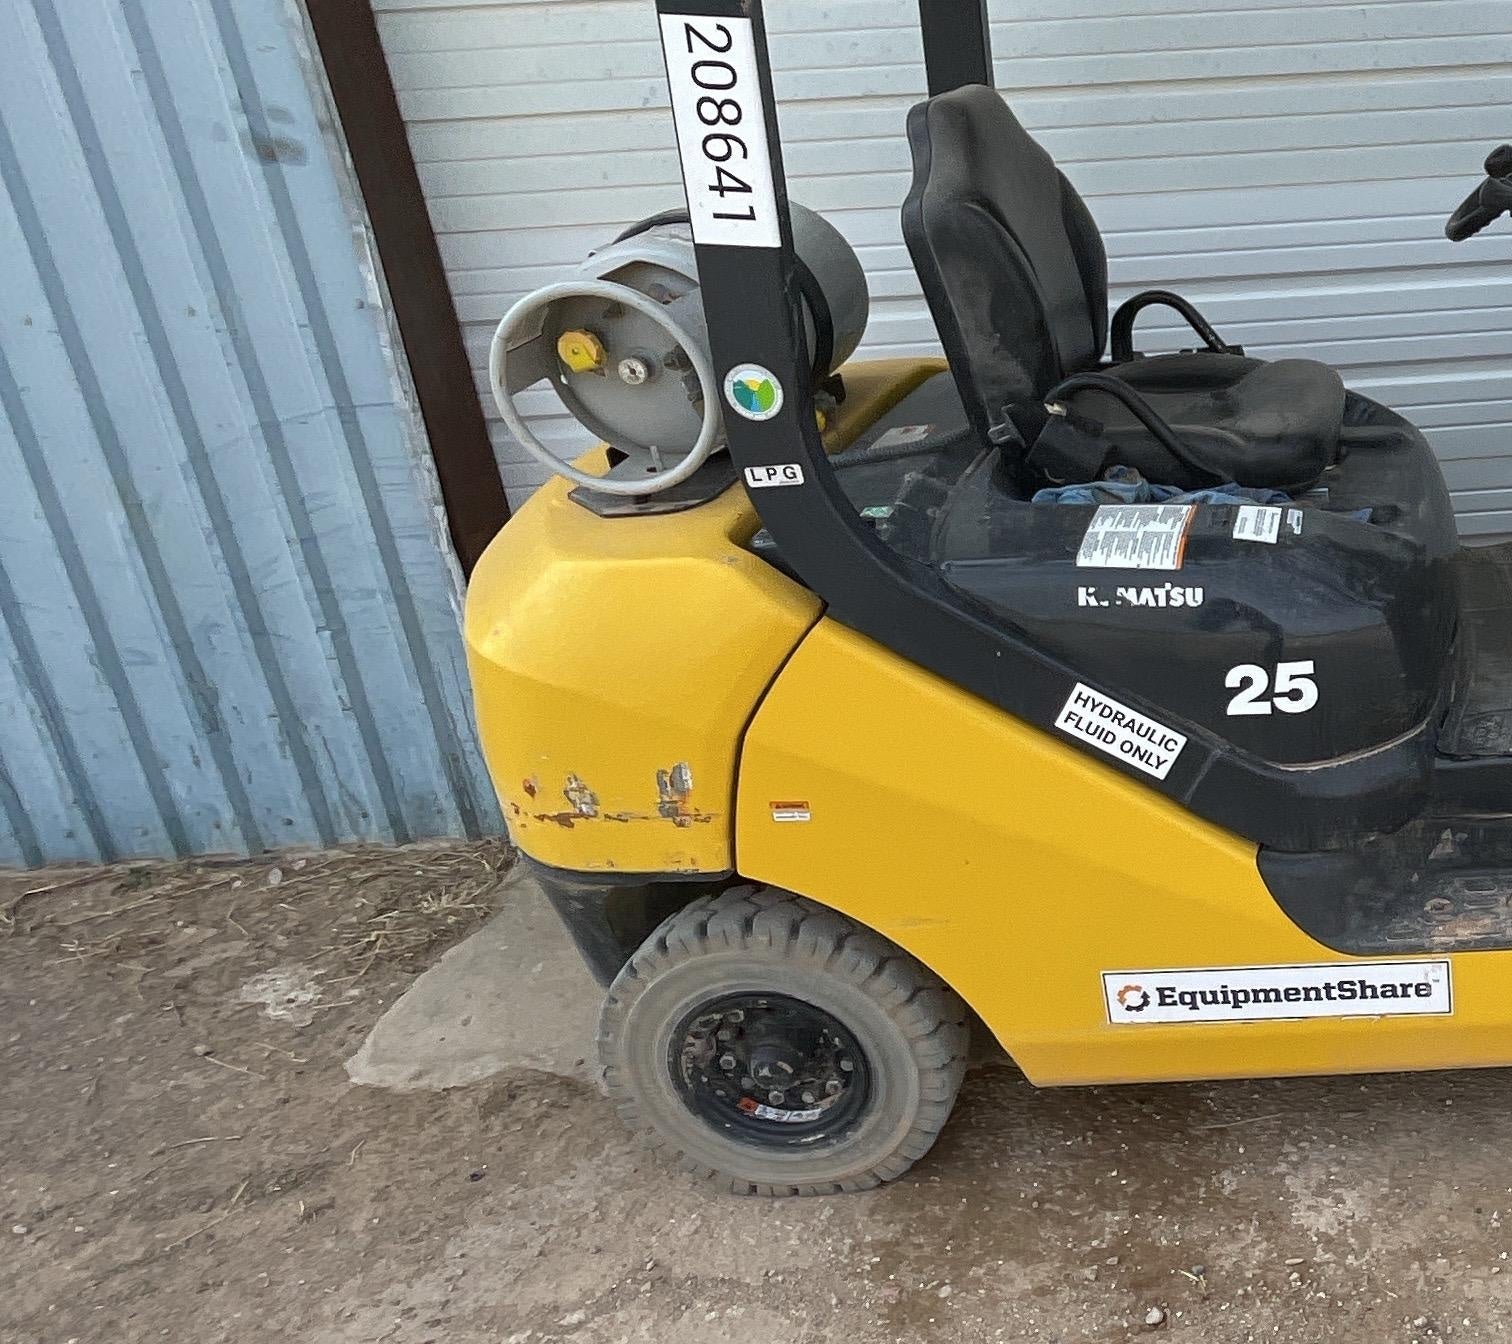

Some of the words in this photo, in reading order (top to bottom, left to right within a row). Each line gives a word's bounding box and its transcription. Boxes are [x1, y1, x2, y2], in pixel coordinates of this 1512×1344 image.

[684, 21, 758, 222] 208641
[1077, 582, 1204, 608] KMATSU
[1224, 660, 1319, 717] 25
[1063, 711, 1117, 745] FLUID
[1119, 739, 1168, 770] ONLY
[1073, 691, 1178, 752] HYDRAULIC
[1155, 979, 1432, 1011] EquipmentShare
